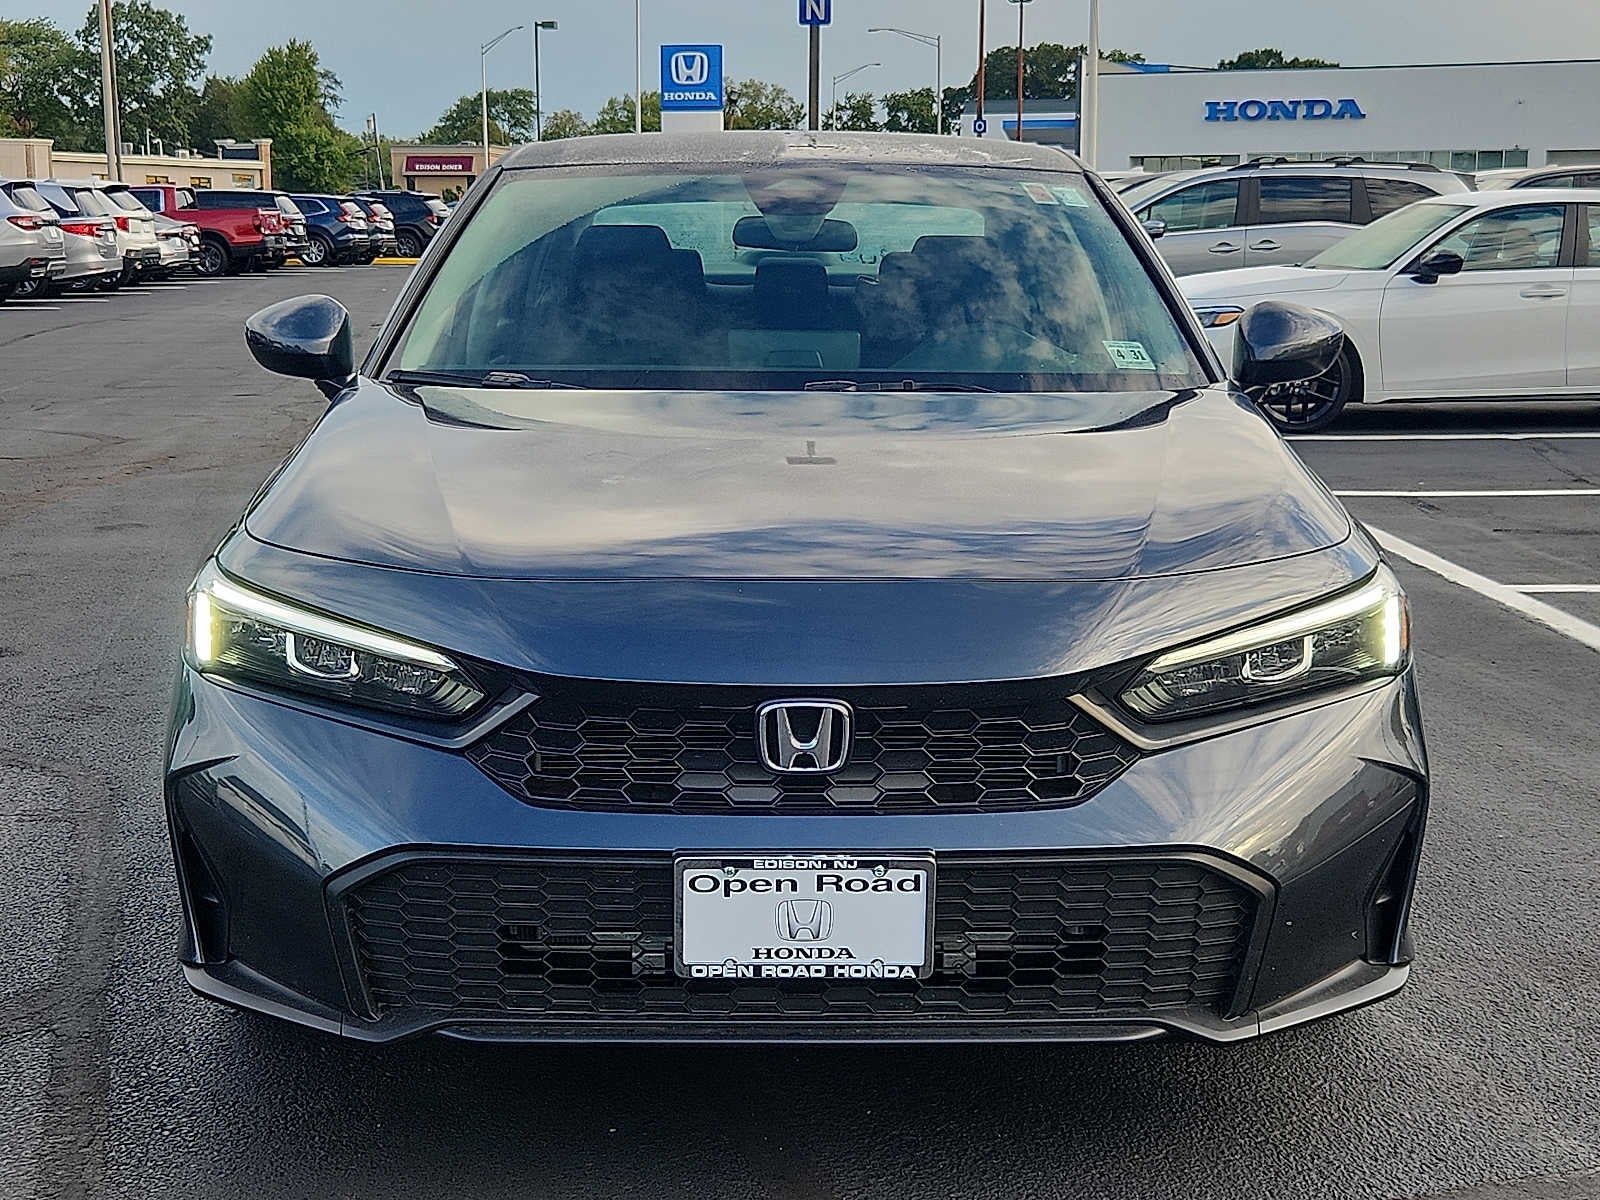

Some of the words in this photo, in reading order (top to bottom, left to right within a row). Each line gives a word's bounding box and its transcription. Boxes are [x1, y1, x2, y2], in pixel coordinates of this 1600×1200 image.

[806, 0, 825, 20] N
[663, 91, 717, 101] HONDA
[1205, 99, 1366, 121] HONDA
[1116, 349, 1125, 360] 4
[1130, 349, 1147, 361] 31
[833, 860, 858, 869] NJ
[688, 874, 798, 898] Open
[816, 873, 921, 892] Road
[752, 948, 856, 959] HONDA
[691, 965, 754, 978] OPEN
[761, 965, 827, 978] ROAD
[833, 965, 917, 978] HONDA
